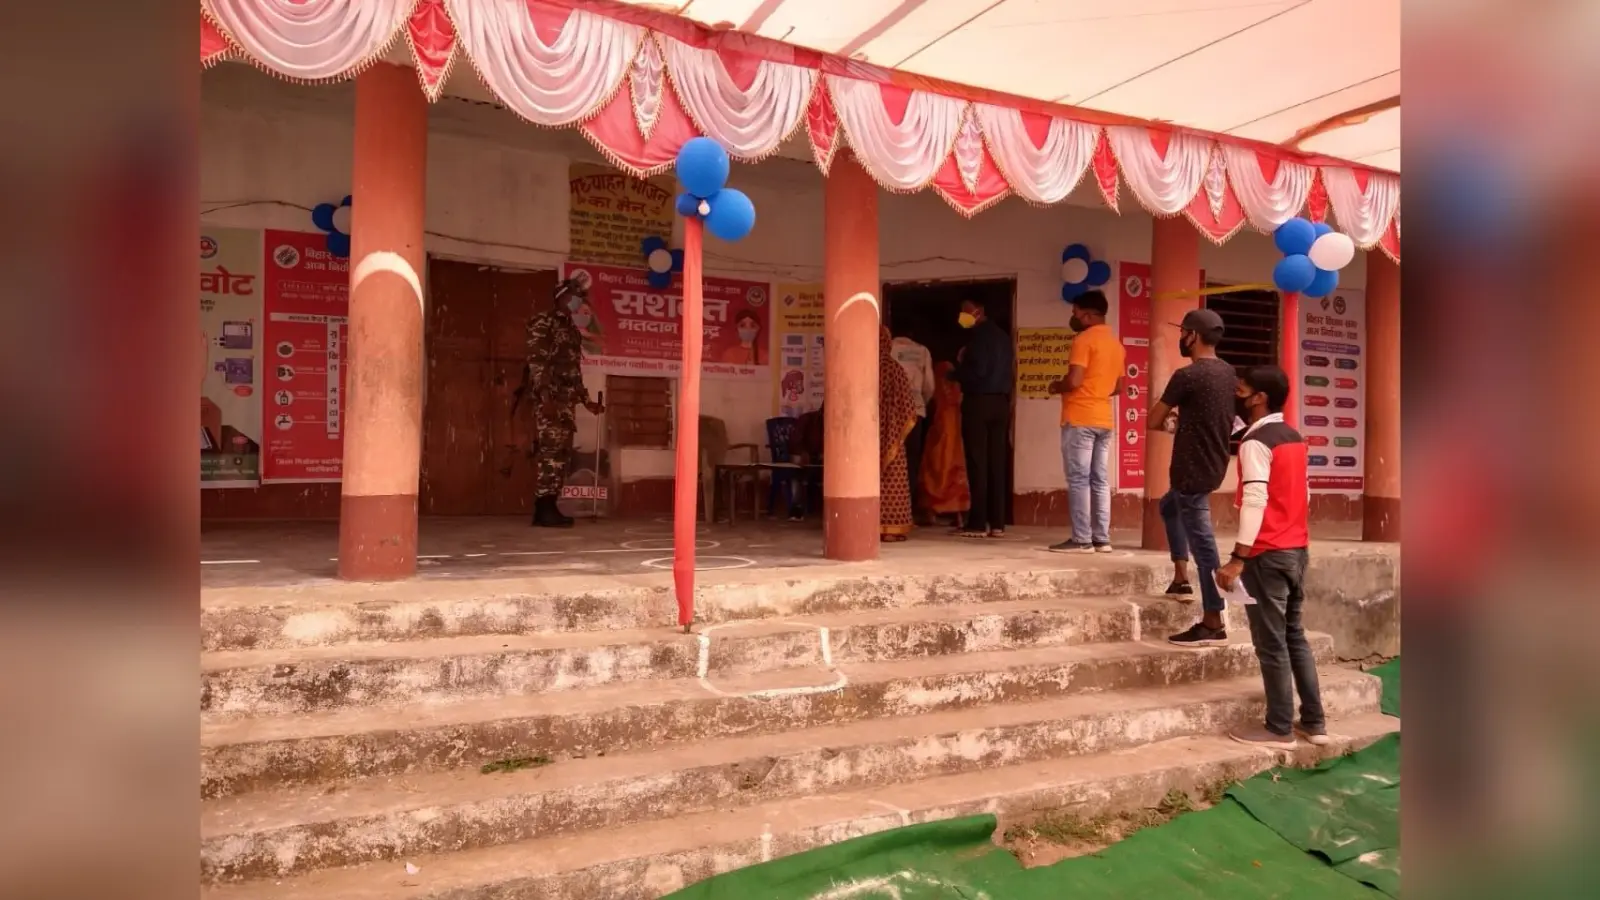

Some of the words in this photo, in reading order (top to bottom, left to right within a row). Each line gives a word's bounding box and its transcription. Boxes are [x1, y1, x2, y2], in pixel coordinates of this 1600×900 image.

[305, 247, 332, 260] बिहार
[611, 289, 730, 323] सशत
[618, 318, 680, 334] मतदान
[563, 487, 606, 497] POLICE
